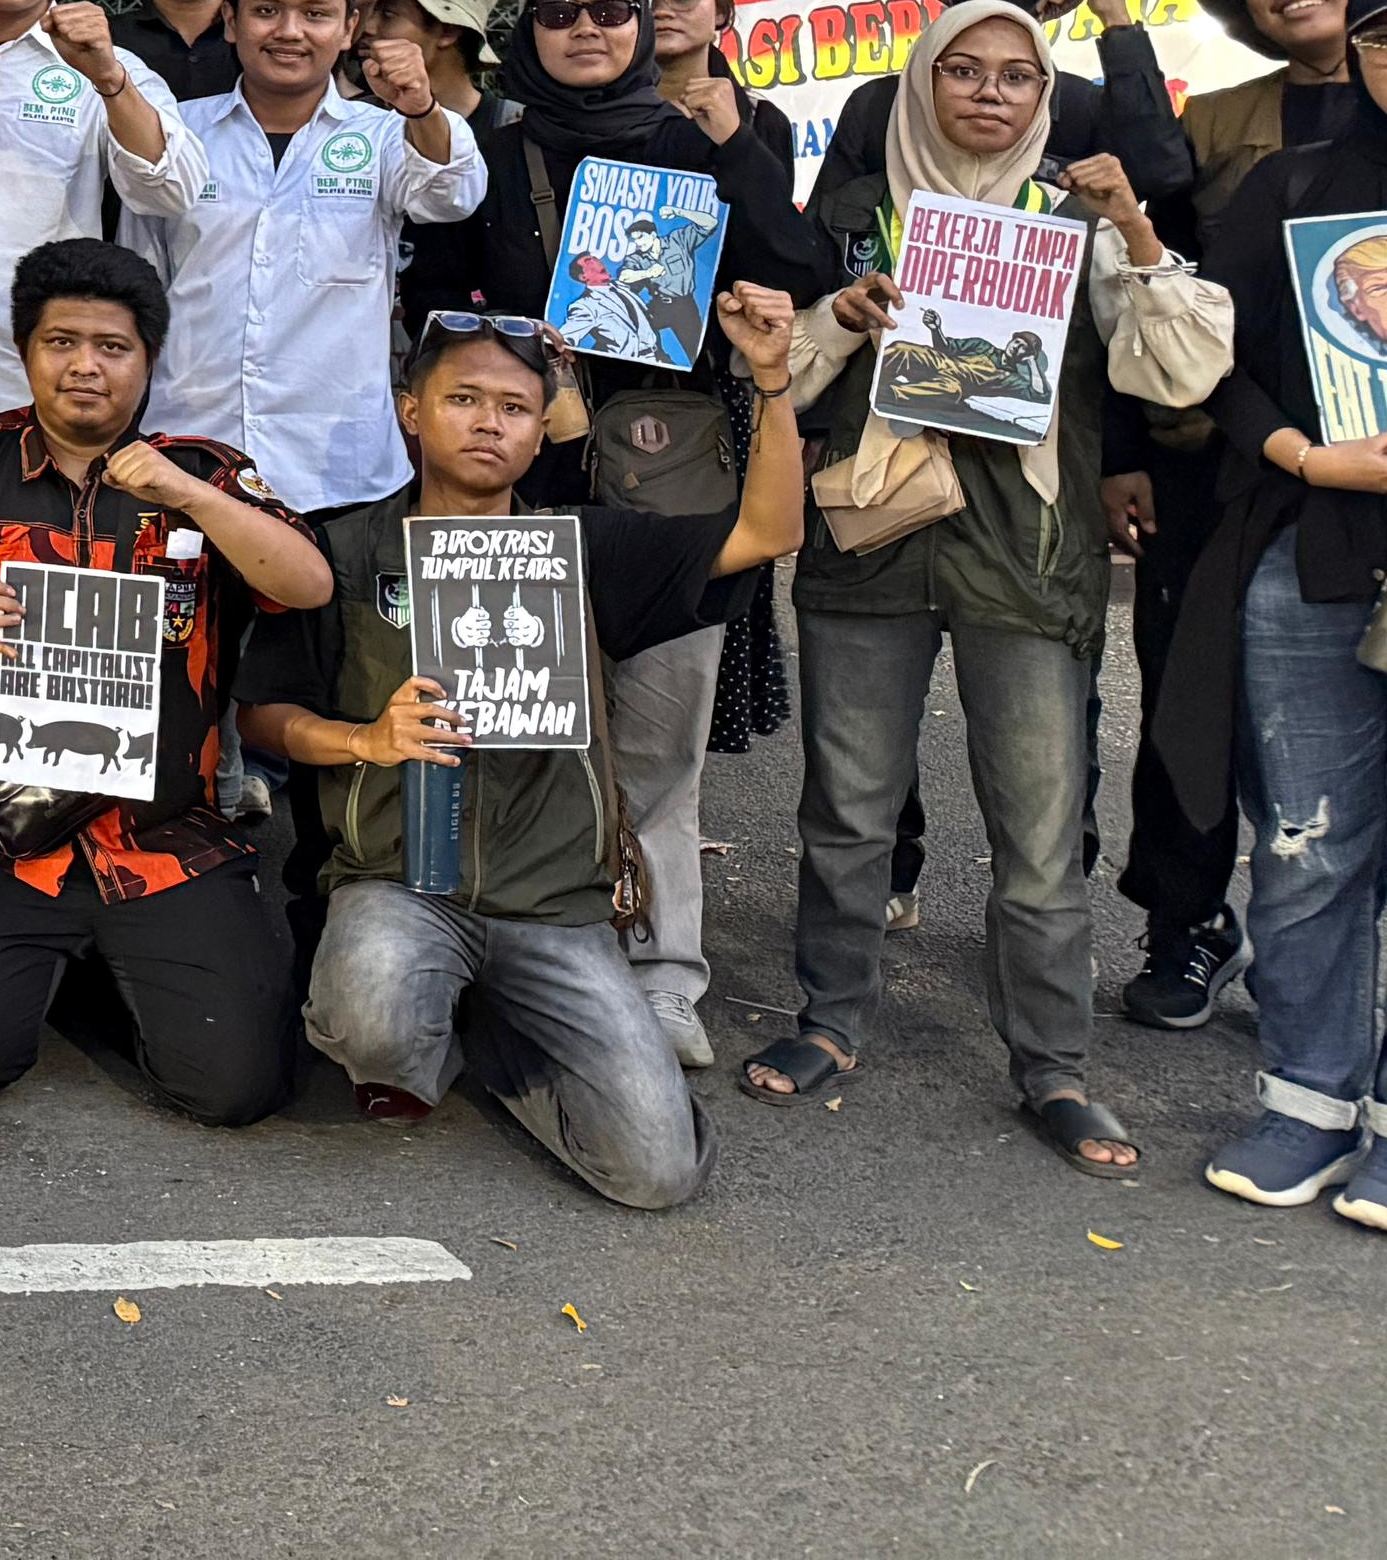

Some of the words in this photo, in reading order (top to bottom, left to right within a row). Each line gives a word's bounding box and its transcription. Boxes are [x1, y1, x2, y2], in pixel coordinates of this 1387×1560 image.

[23, 102, 44, 114] BEM
[316, 177, 339, 188] BEM
[579, 162, 660, 212] SMASH
[665, 174, 720, 214] YOUR
[908, 206, 1003, 258] BEKERJA
[1012, 223, 1080, 272] TANPA
[899, 244, 1073, 321] DIPERBUDAK
[430, 529, 555, 557] BIROKRASI
[420, 556, 496, 580] TUMPUL
[497, 556, 569, 581] KEATAS
[2, 566, 160, 655] ACAB
[1, 641, 36, 670] ALL
[42, 645, 156, 683] CAPITALIST
[0, 668, 42, 699] ARE
[46, 673, 154, 711] BASTARD!
[453, 666, 551, 702] TAJAM
[432, 700, 577, 738] KEBAWAH
